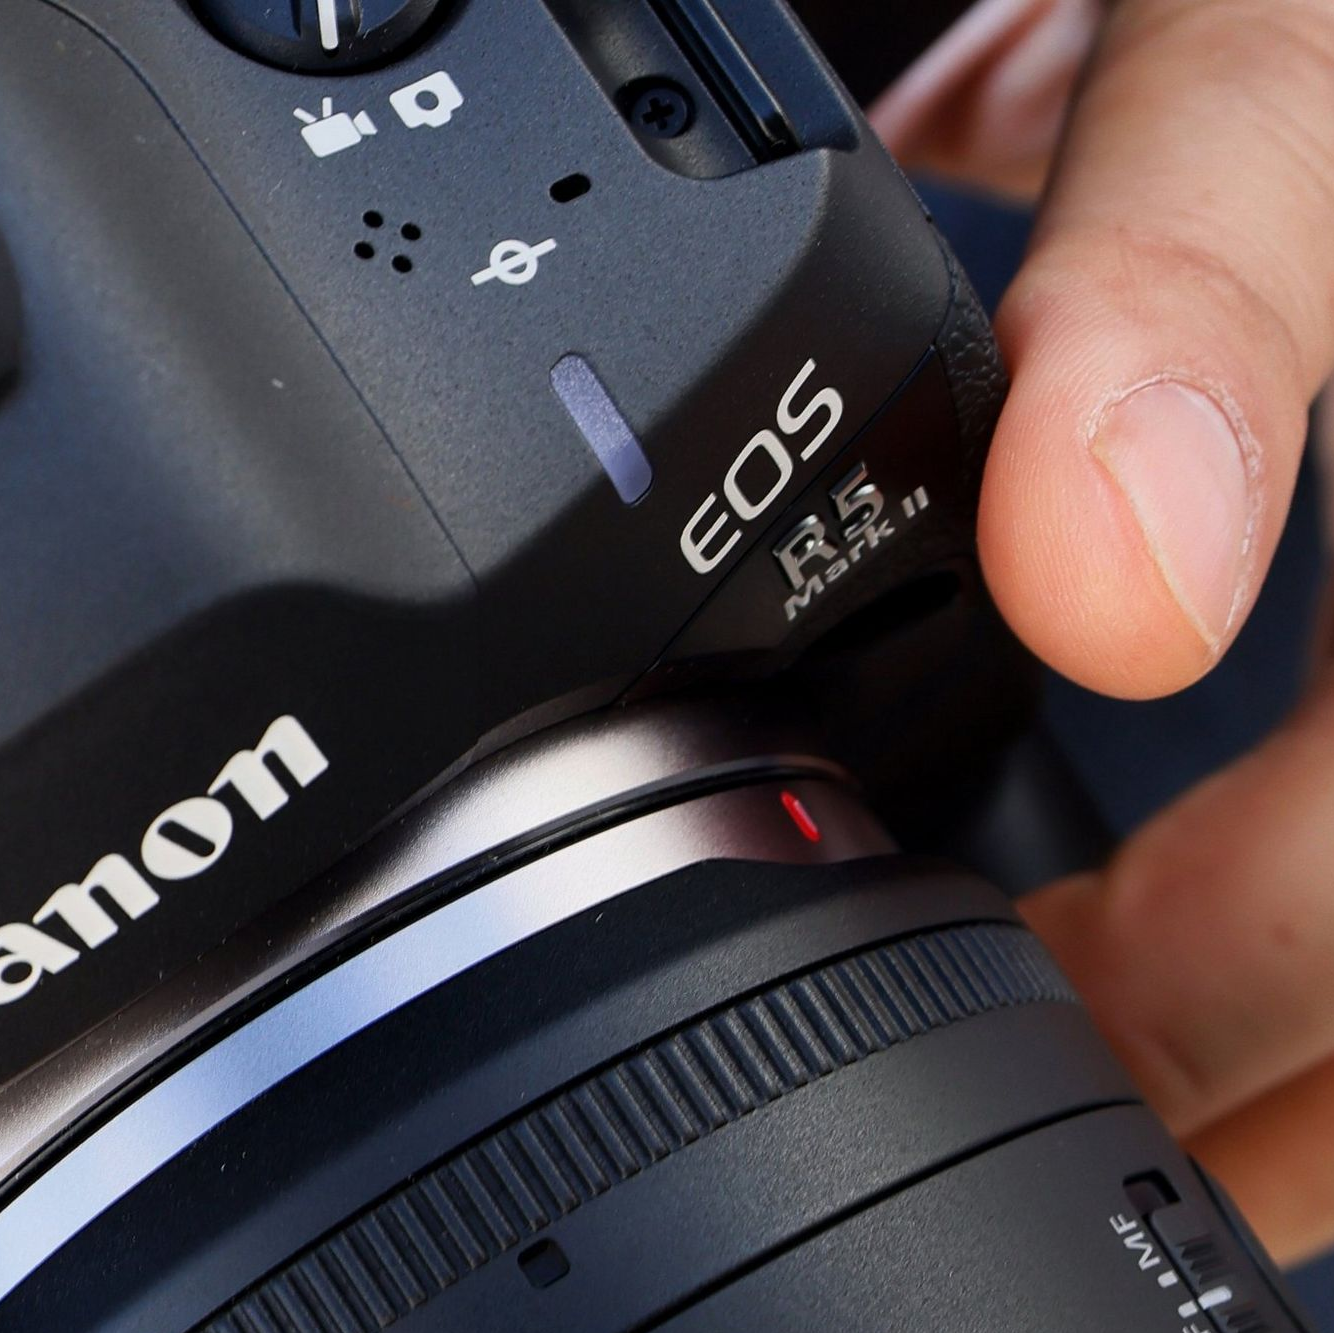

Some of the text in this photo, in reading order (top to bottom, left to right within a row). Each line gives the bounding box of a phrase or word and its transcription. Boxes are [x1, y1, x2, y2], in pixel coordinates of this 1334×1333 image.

[680, 358, 843, 574] EOS
[772, 461, 884, 591] R5
[784, 518, 895, 621] Mark
[1109, 1213, 1160, 1271] MF
